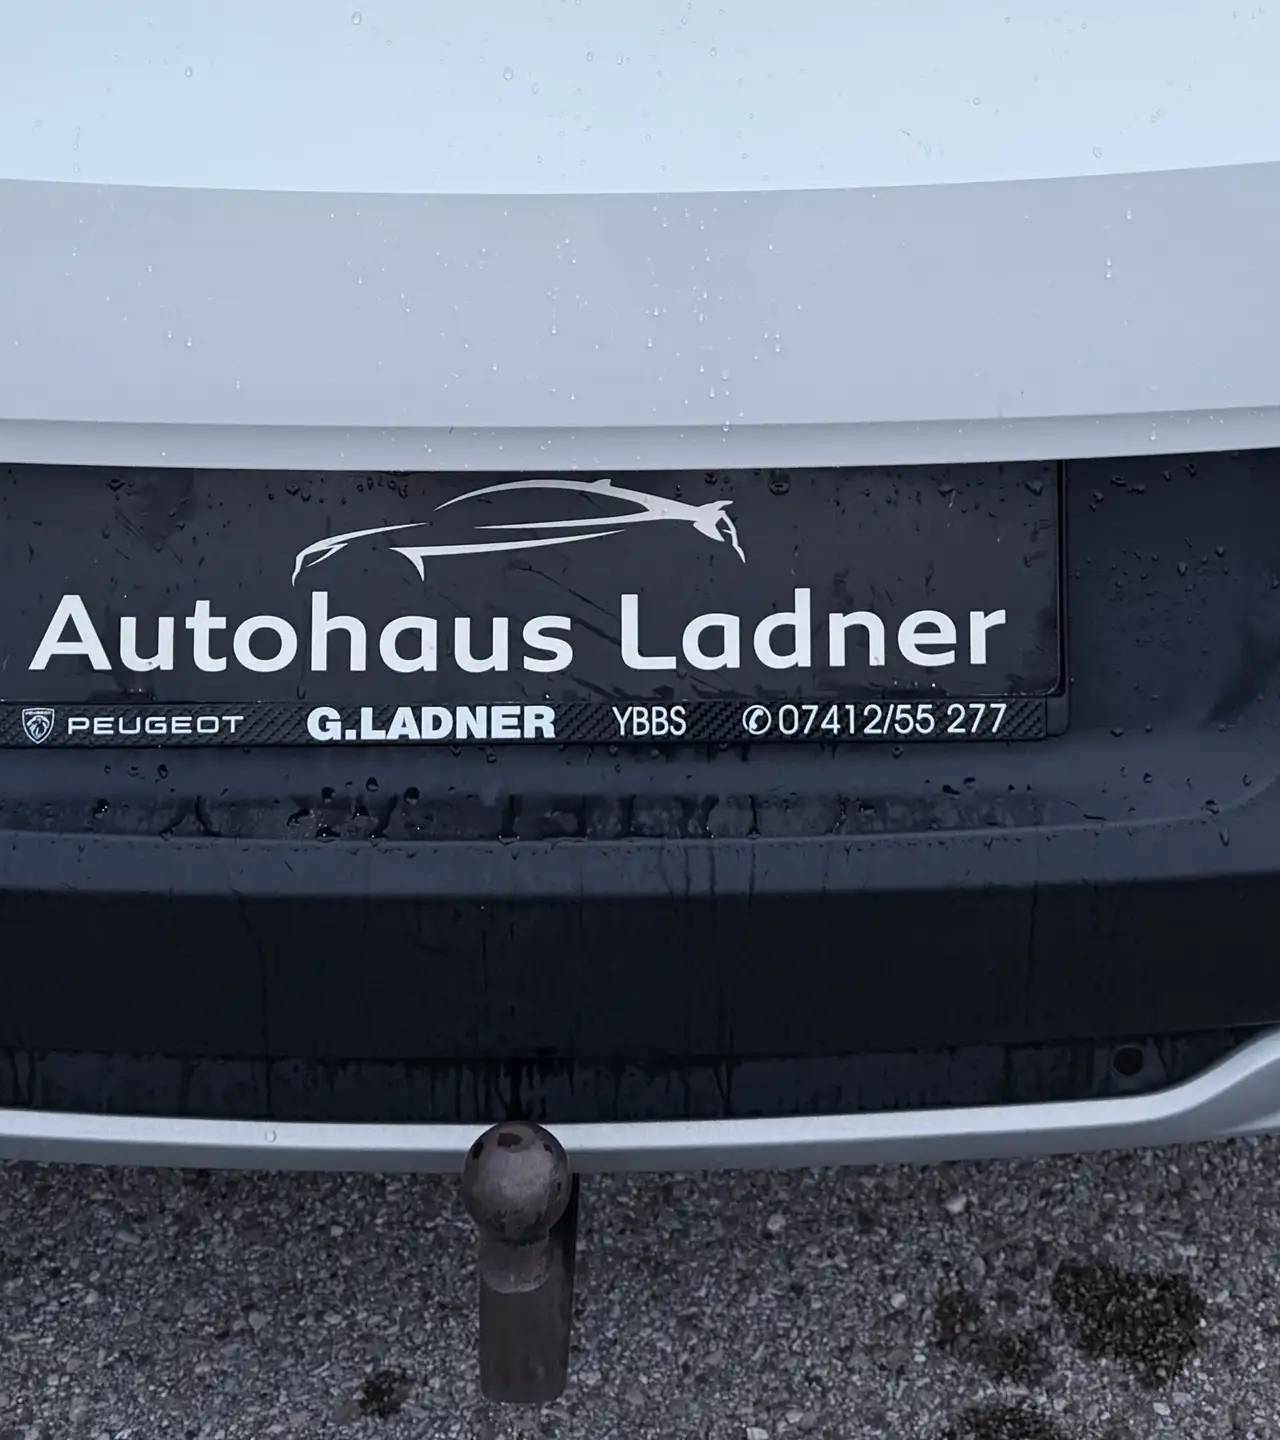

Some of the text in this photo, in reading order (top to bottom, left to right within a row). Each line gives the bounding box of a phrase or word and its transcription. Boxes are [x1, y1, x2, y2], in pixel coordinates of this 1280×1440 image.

[28, 587, 1006, 673] Autohaus Ladner
[67, 702, 1007, 741] PEUGEOT G.LADNER YBBS 07412/55 277
